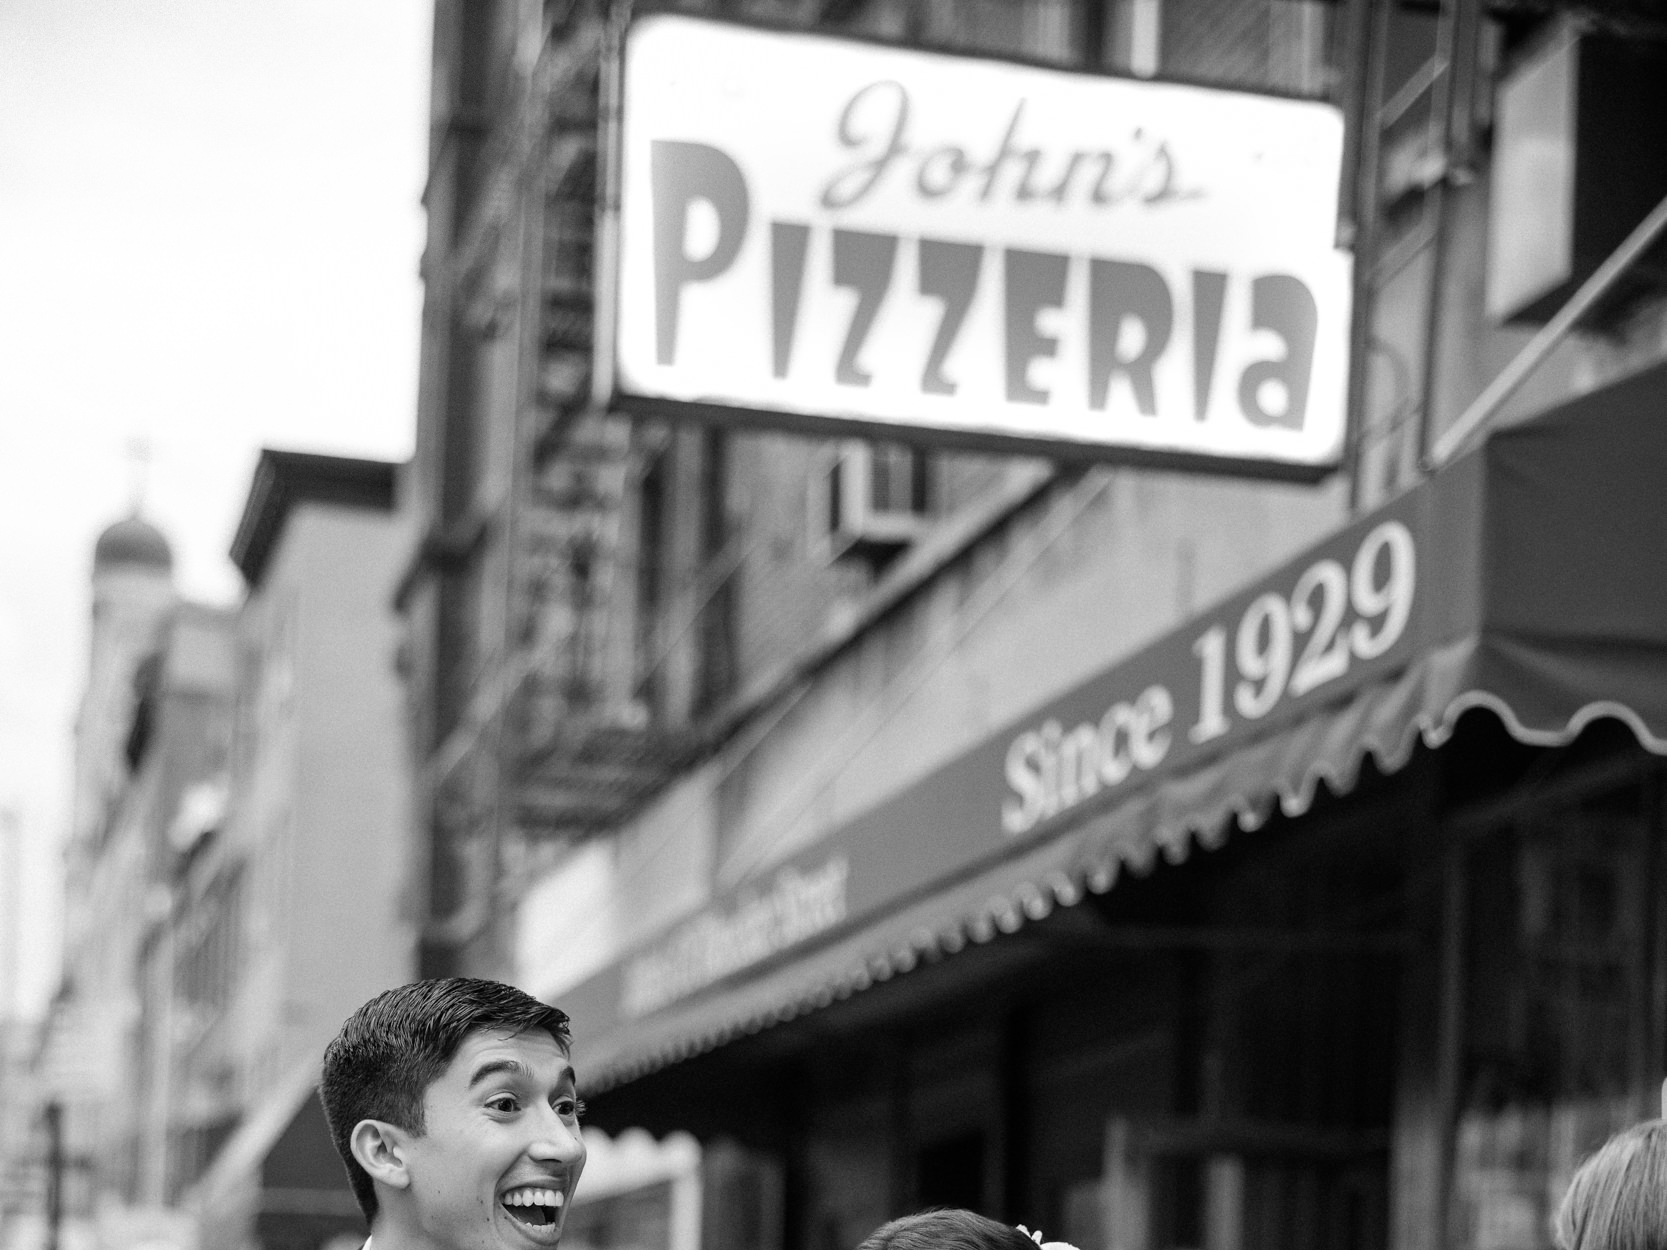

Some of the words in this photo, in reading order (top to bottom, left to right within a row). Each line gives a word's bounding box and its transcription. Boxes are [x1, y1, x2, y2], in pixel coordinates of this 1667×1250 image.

[821, 78, 1204, 212] John's
[1001, 682, 1174, 834] Since
[1187, 519, 1417, 744] 1929
